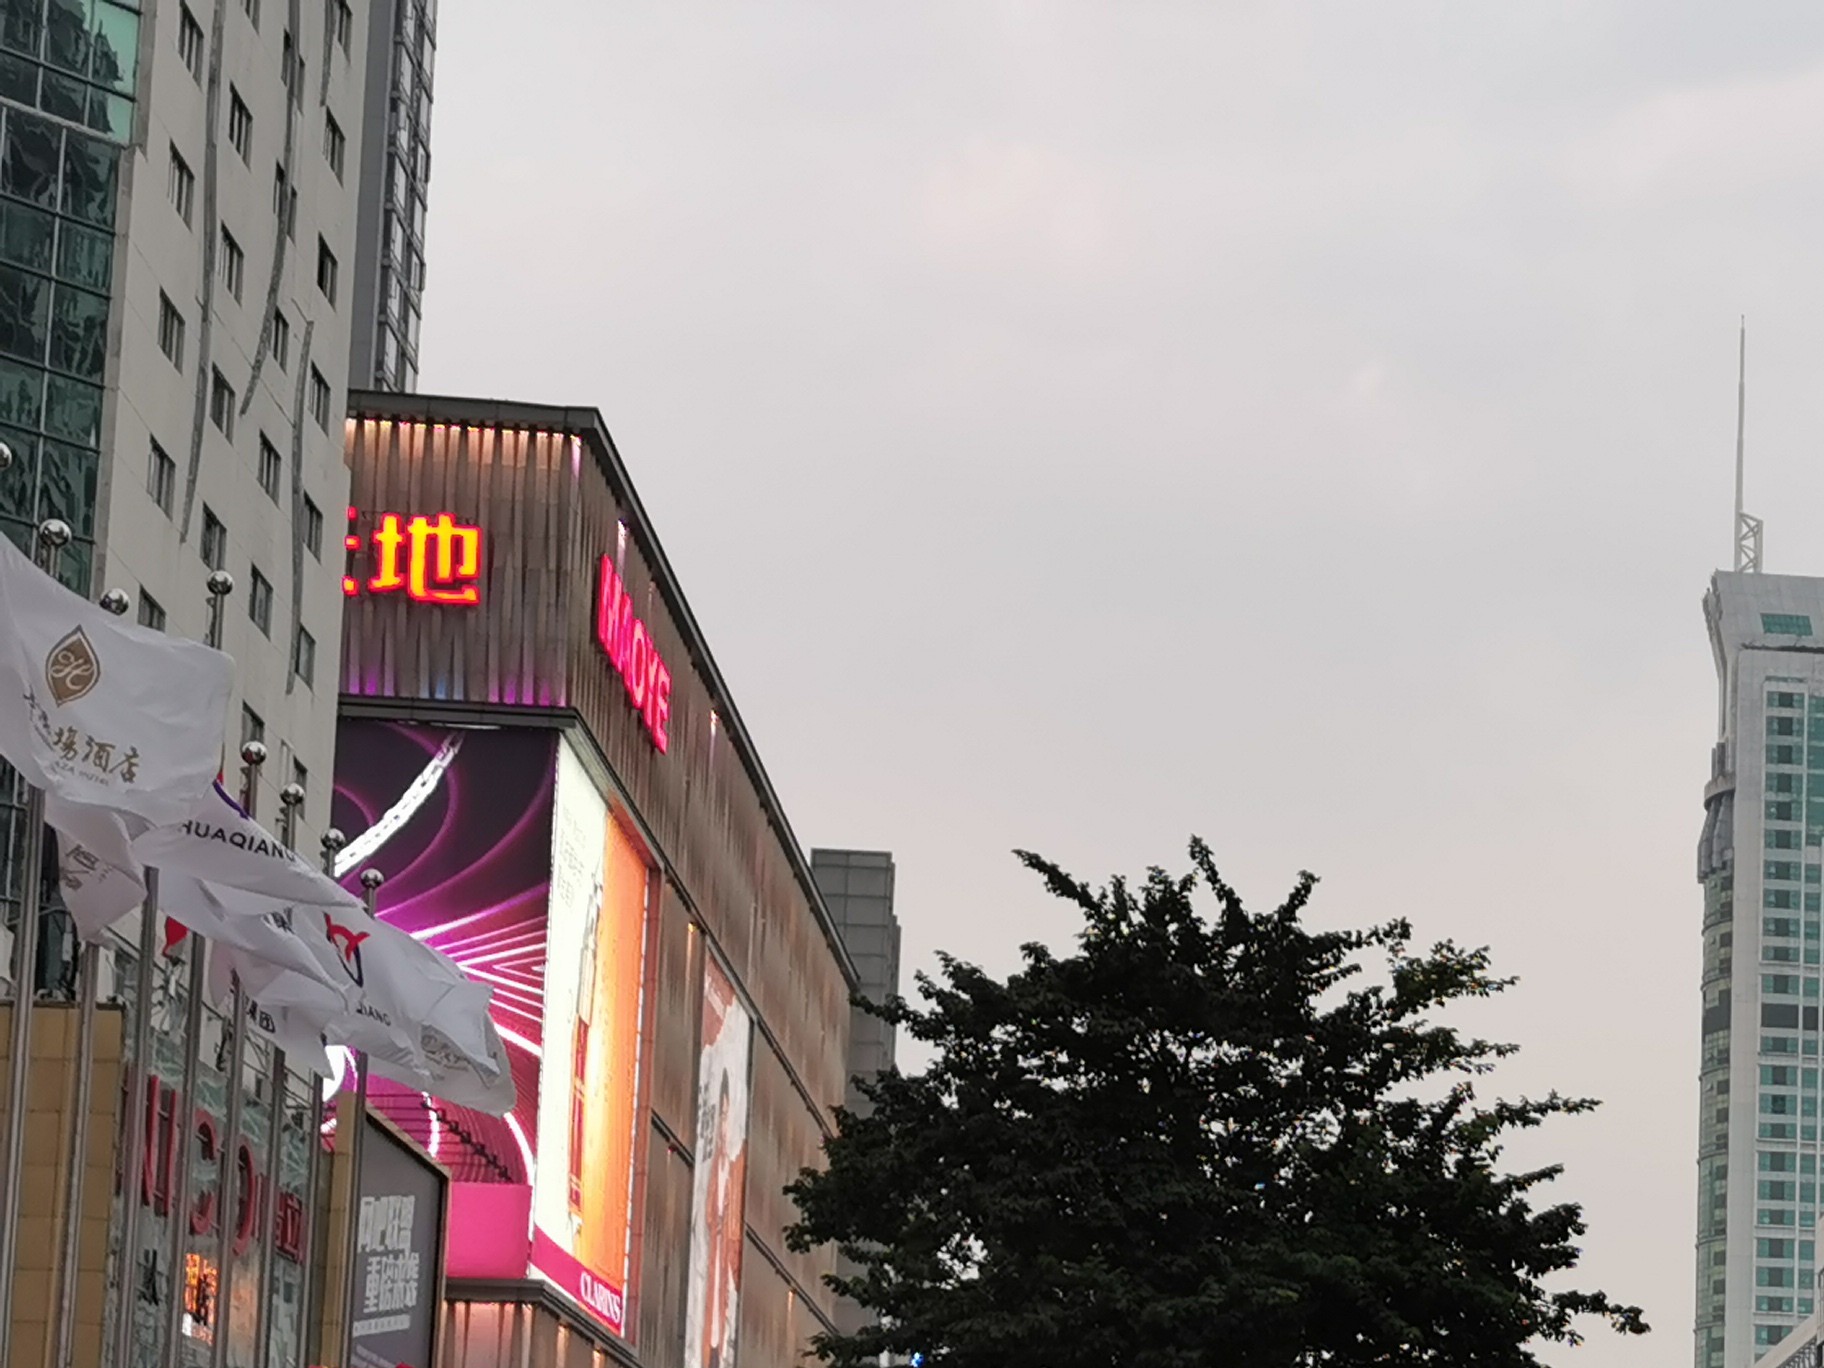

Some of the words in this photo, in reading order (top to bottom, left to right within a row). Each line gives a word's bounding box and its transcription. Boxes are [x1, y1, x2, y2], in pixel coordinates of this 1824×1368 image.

[343, 506, 482, 605] 地
[598, 552, 672, 755] MAOYE
[580, 1270, 622, 1324] CLARINS
